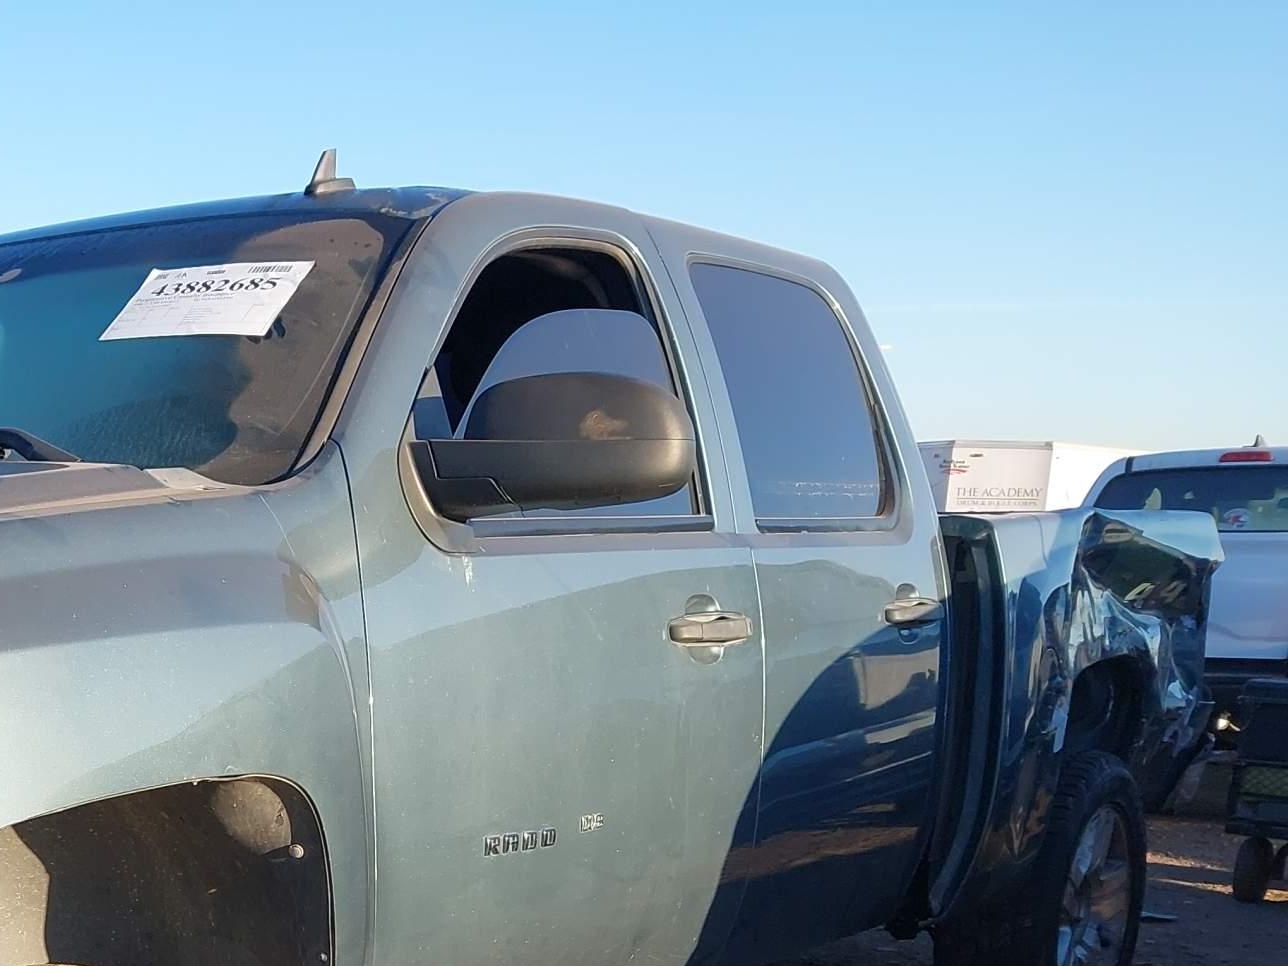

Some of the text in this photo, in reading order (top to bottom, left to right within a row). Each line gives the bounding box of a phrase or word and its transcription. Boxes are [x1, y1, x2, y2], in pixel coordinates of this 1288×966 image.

[152, 278, 282, 296] 43882685
[956, 487, 1044, 498] THE ACADEMY
